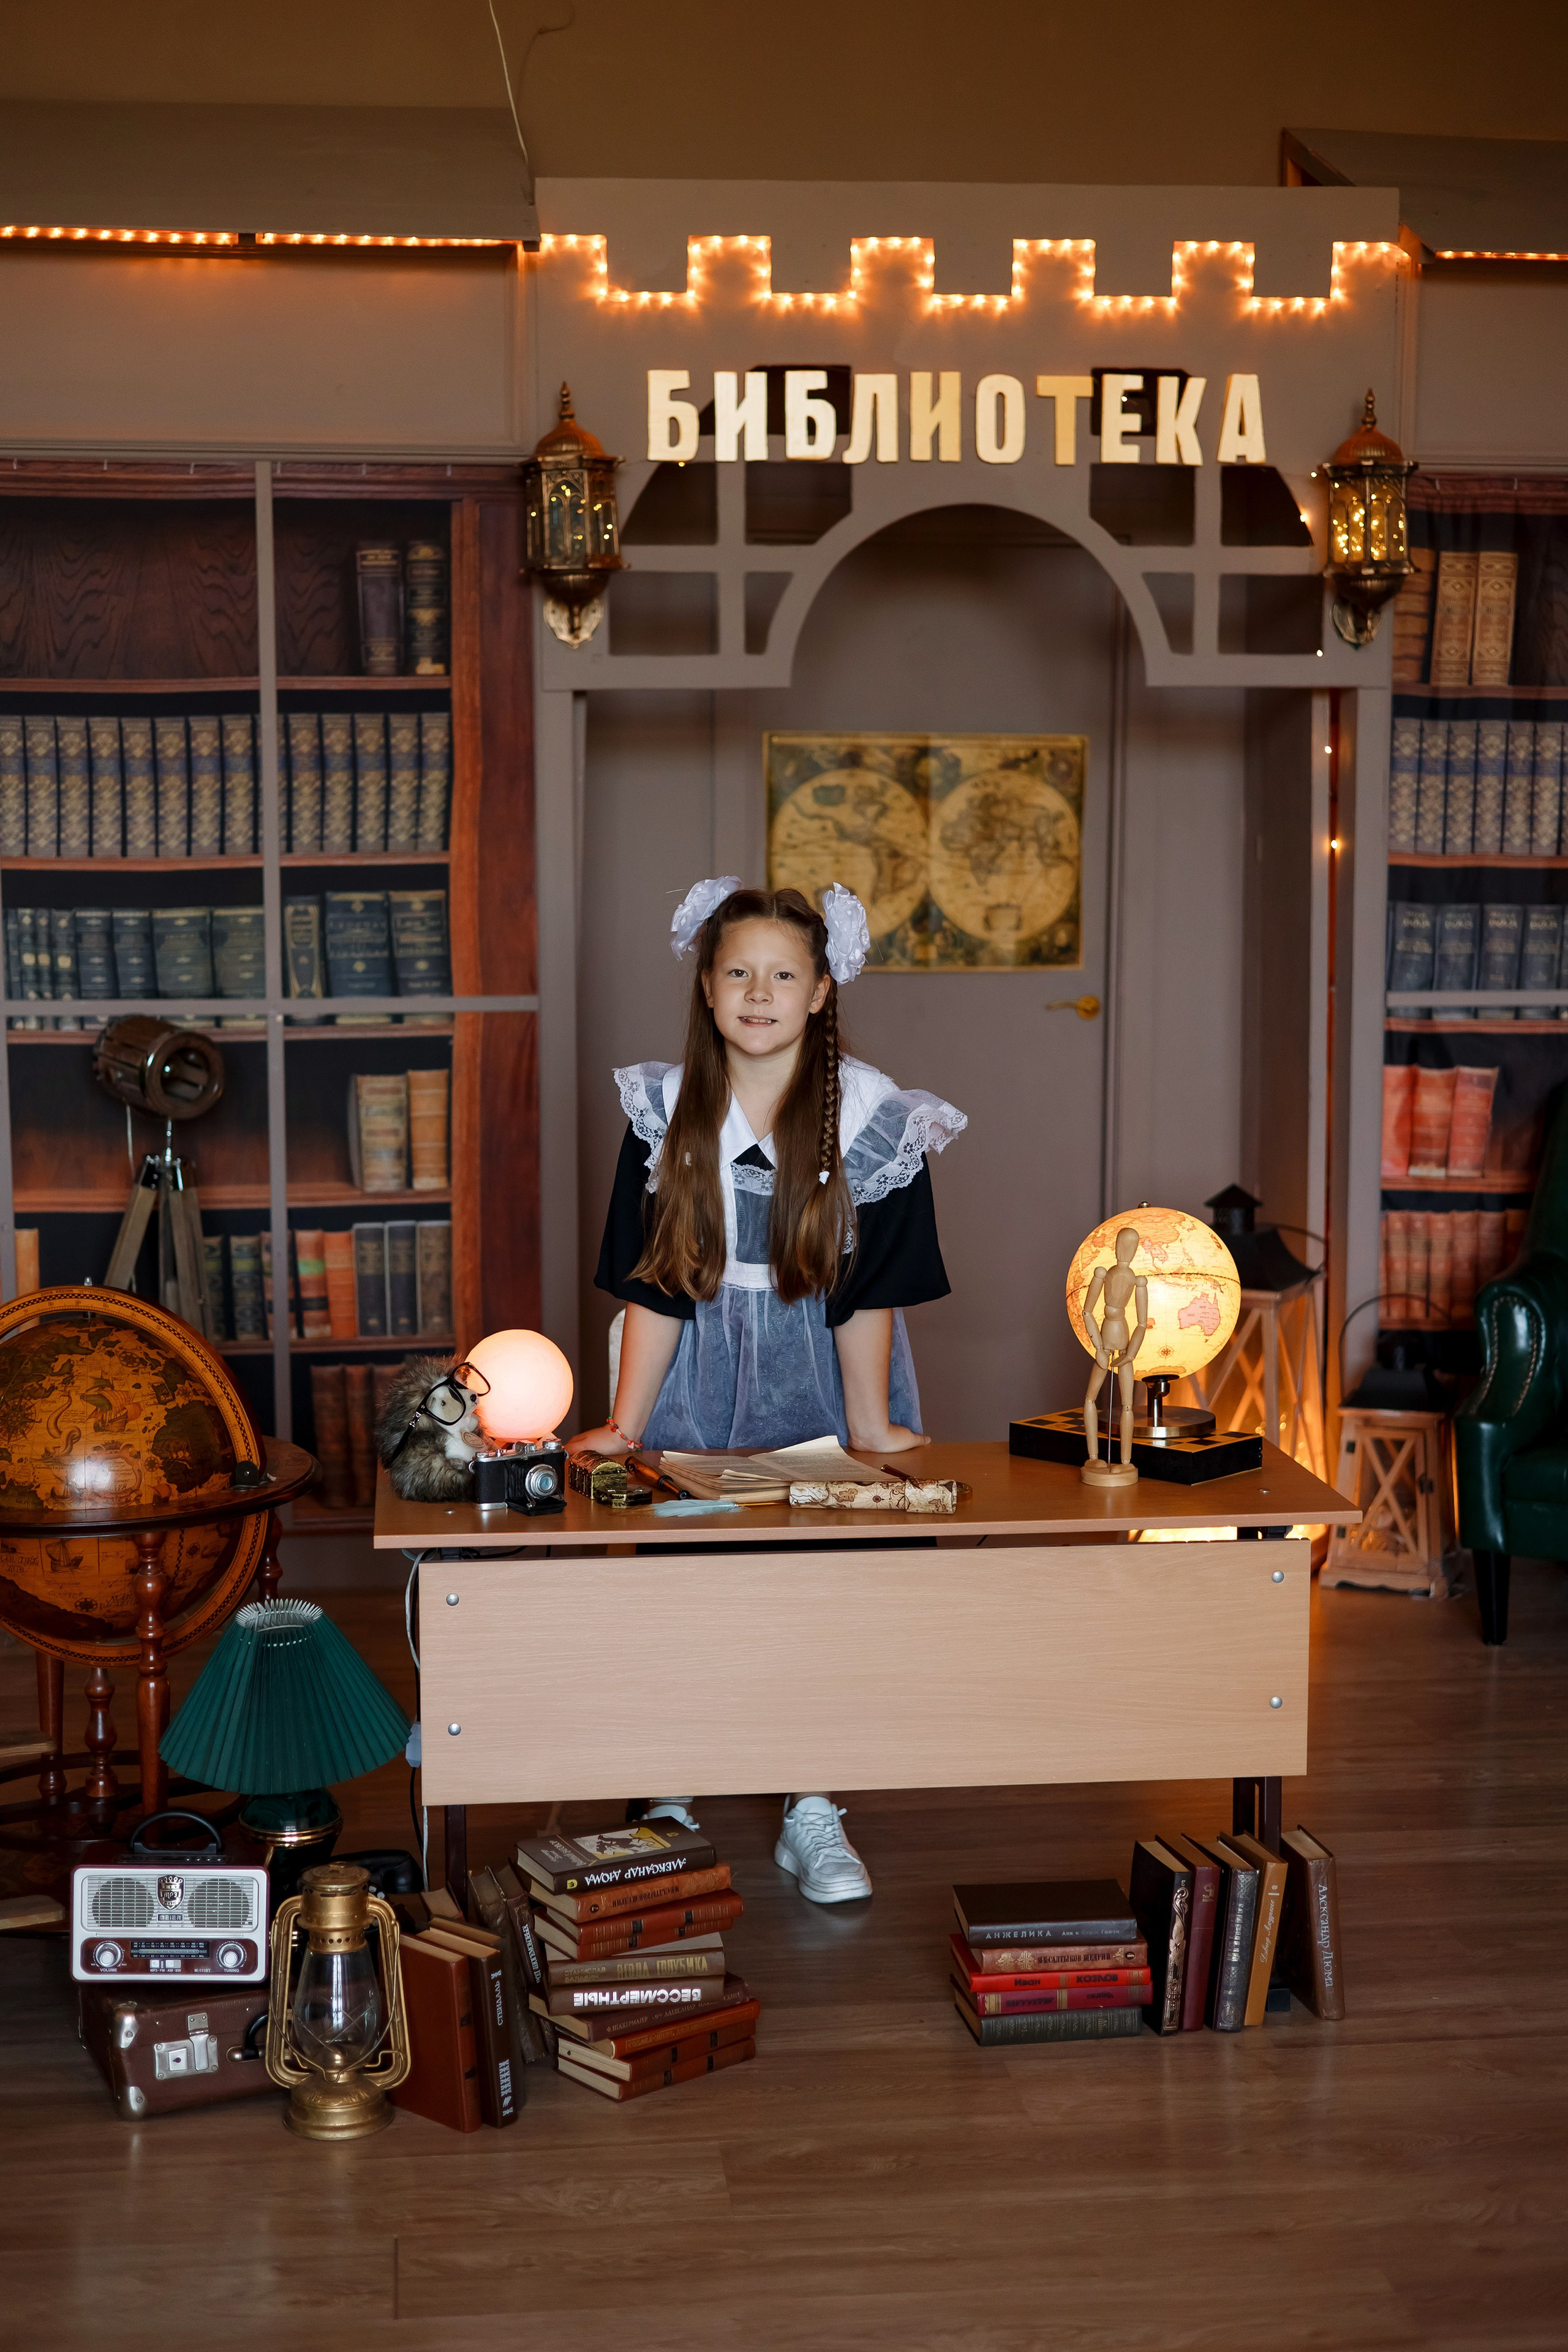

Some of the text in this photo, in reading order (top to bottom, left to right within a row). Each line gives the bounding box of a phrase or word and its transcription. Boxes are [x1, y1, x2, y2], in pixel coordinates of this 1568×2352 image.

[647, 369, 1267, 466] БИБЛИОТЕКА
[584, 1857, 687, 1887] АЛЕКСАНДР ДЮМА
[985, 1930, 1052, 1939] АНЖЕЛИКА
[1317, 1884, 1333, 1987] Александр Дюма
[1014, 1973, 1118, 1986] Иван КОЗЛОВ
[573, 1988, 701, 2007] БЕССМЕРТНЫЕ
